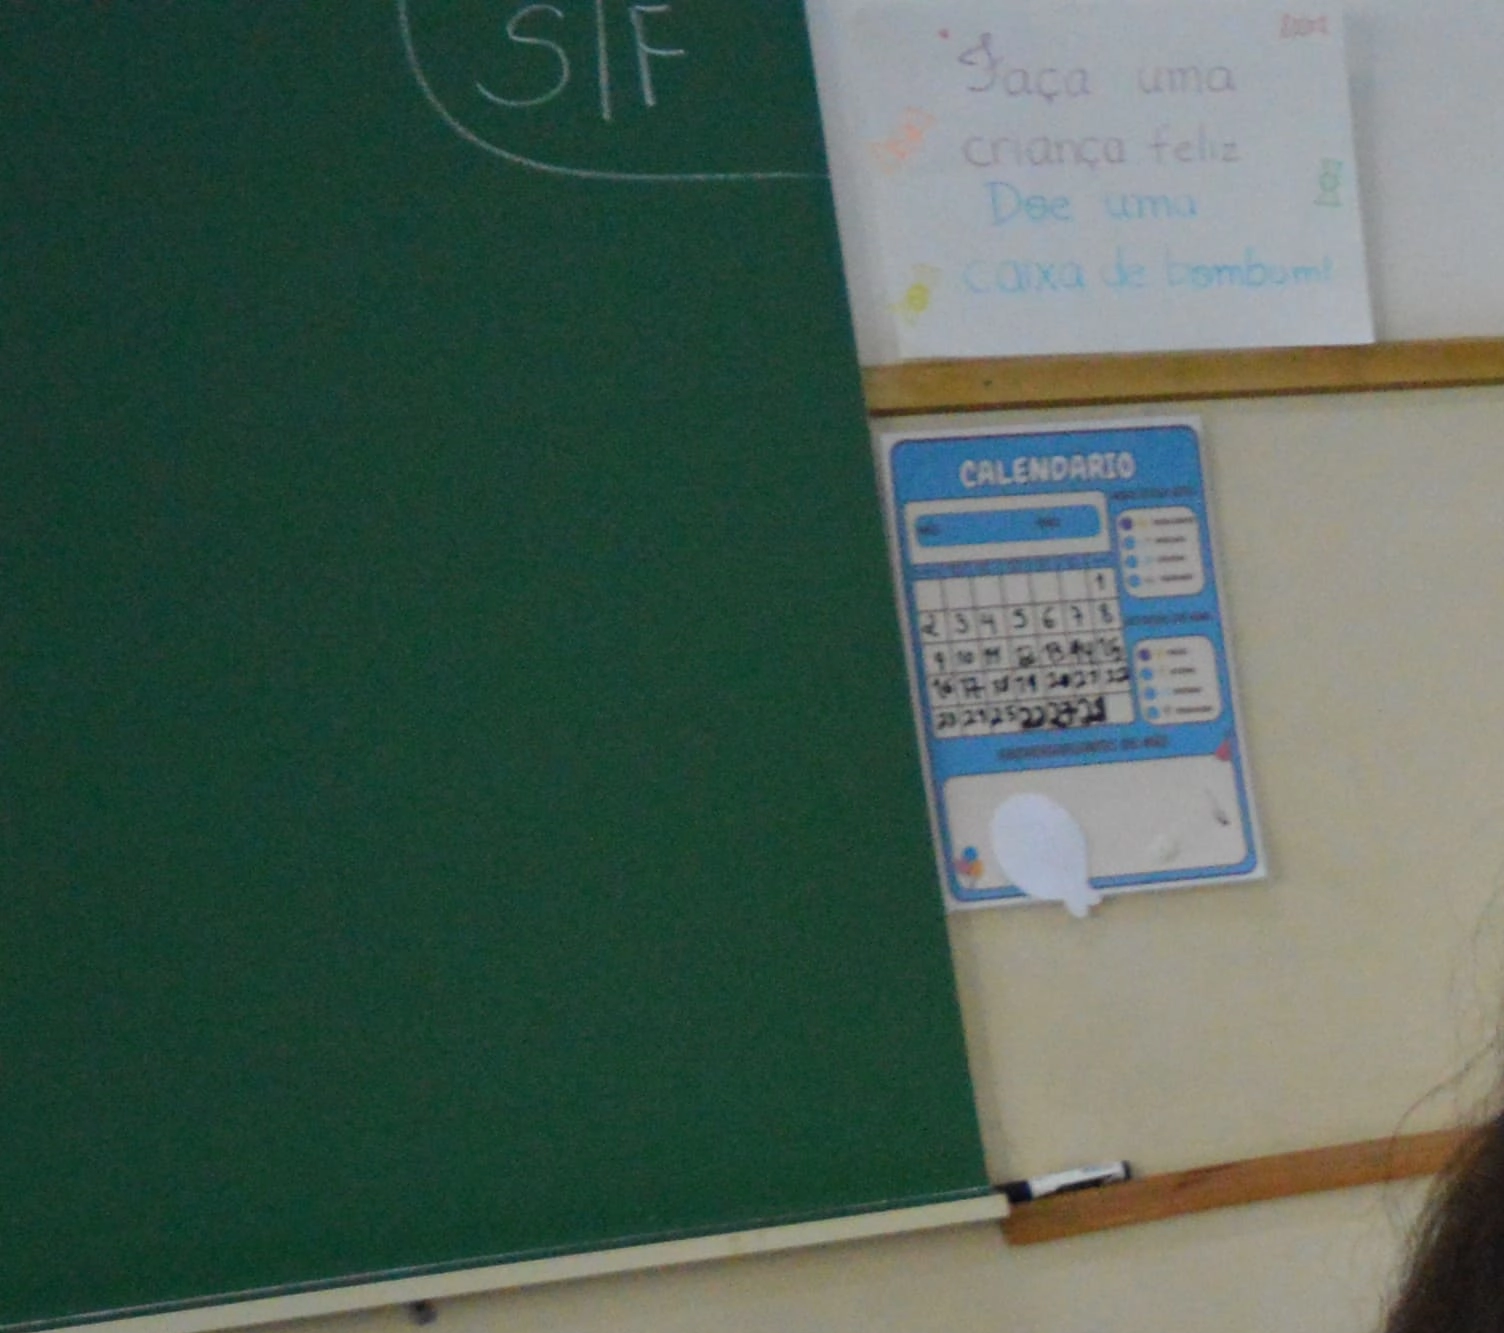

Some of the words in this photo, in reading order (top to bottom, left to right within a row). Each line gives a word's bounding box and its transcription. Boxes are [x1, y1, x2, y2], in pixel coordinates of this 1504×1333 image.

[1136, 63, 1237, 95] uma
[961, 132, 1126, 170] criança
[1148, 124, 1241, 163] feliz
[985, 180, 1073, 227] Doe
[1104, 191, 1198, 221] uma
[962, 257, 1086, 296] caixa
[1102, 244, 1146, 289] de
[1013, 608, 1028, 629] 5
